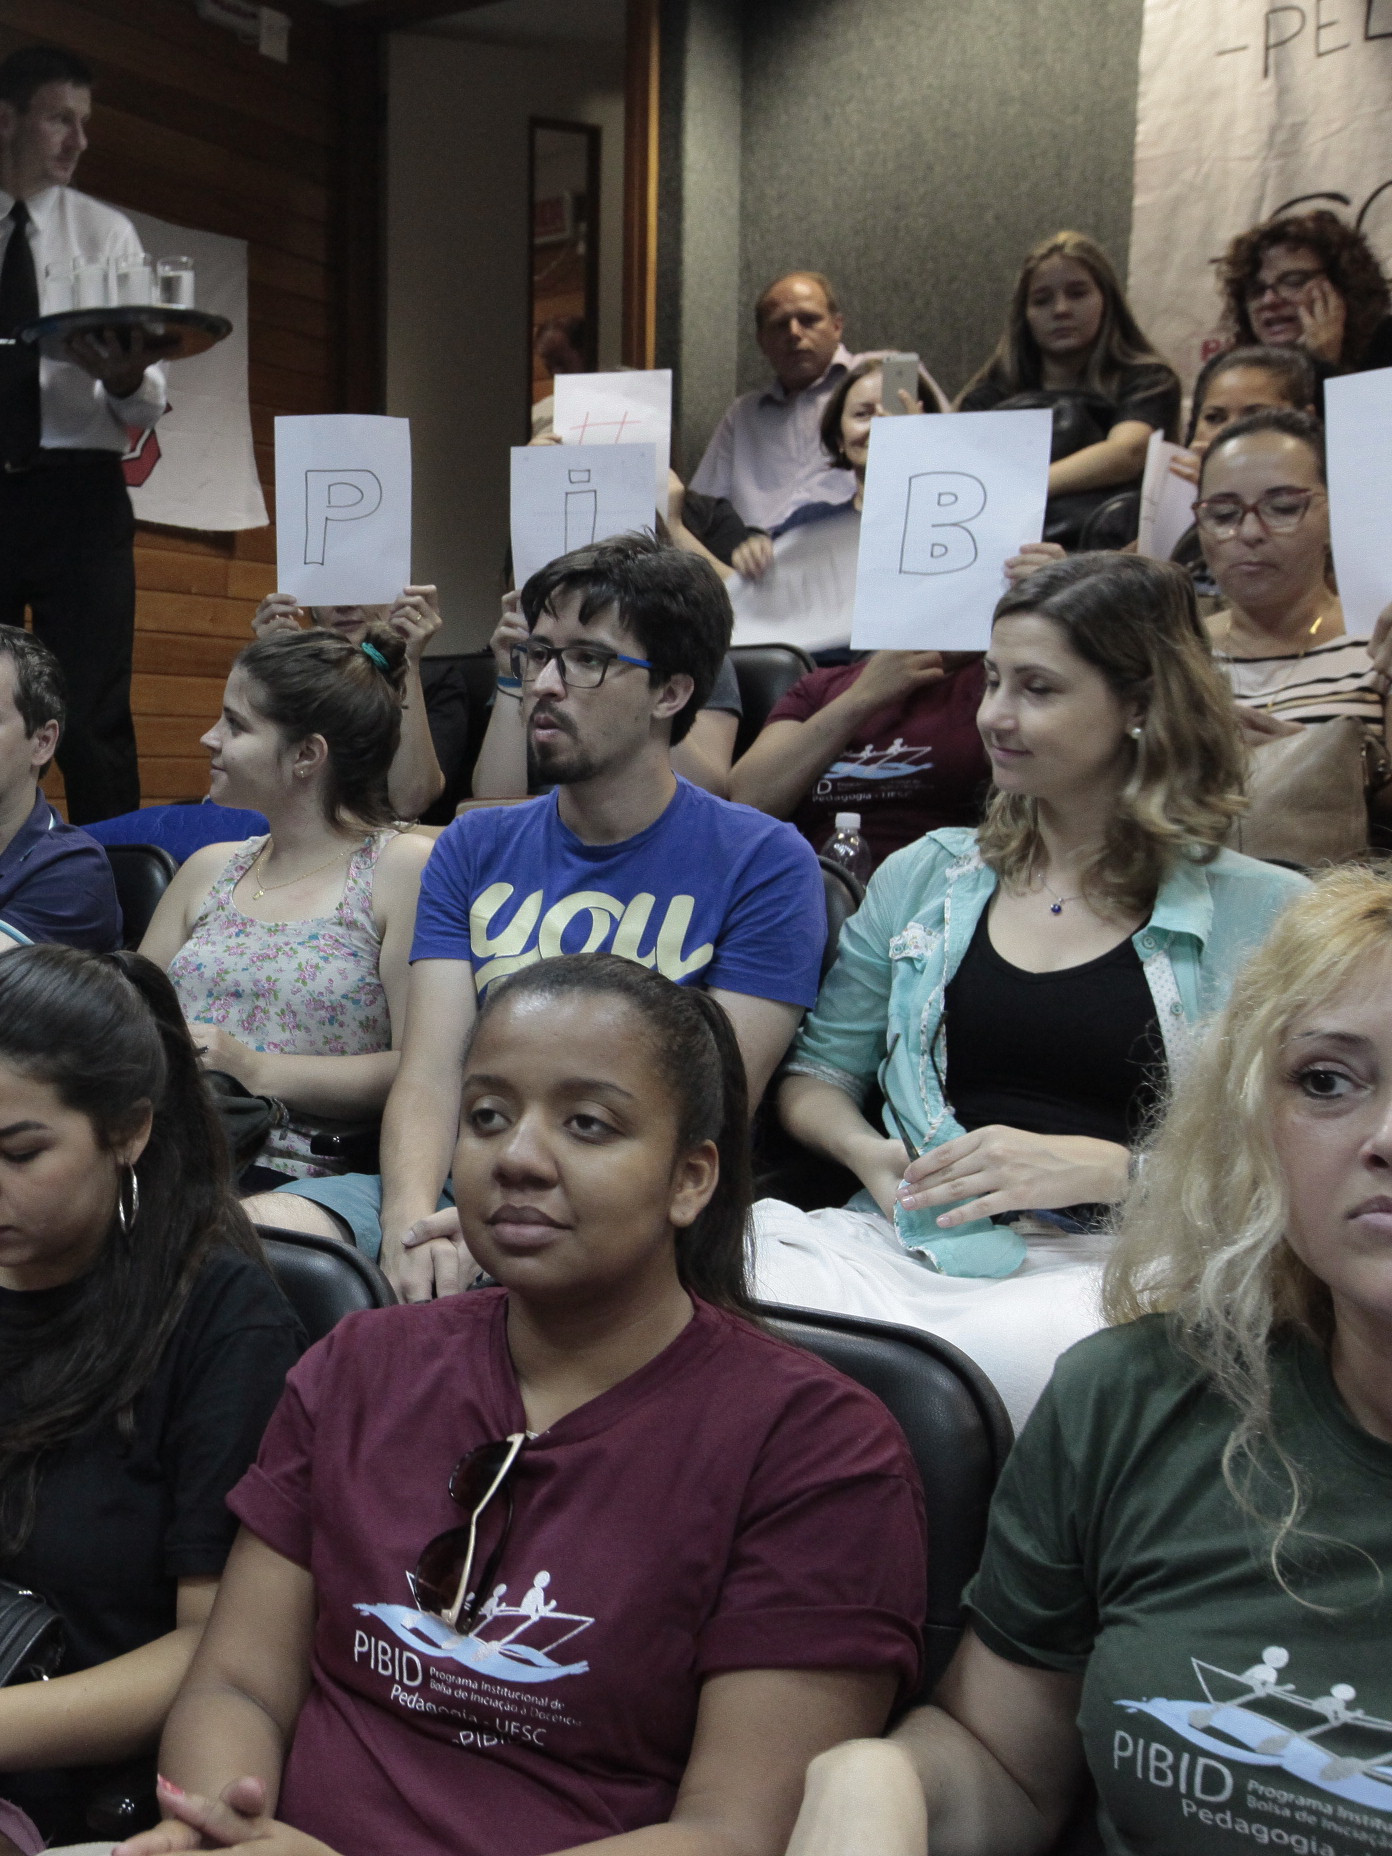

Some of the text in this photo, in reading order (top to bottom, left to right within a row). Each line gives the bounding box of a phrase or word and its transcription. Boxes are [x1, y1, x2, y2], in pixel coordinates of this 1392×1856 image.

[304, 468, 383, 566] P
[898, 470, 988, 577] B
[353, 1629, 424, 1688] PIBID
[429, 1666, 479, 1690] Programa
[481, 1680, 549, 1707] Institucional
[454, 1687, 469, 1700] de
[495, 1717, 548, 1747] UFSC
[1112, 1729, 1235, 1802] PIBID
[1246, 1779, 1334, 1816] Programa
[1246, 1793, 1292, 1818] Bolsa
[1294, 1809, 1318, 1826] de
[1181, 1797, 1336, 1856] Pedagogia
